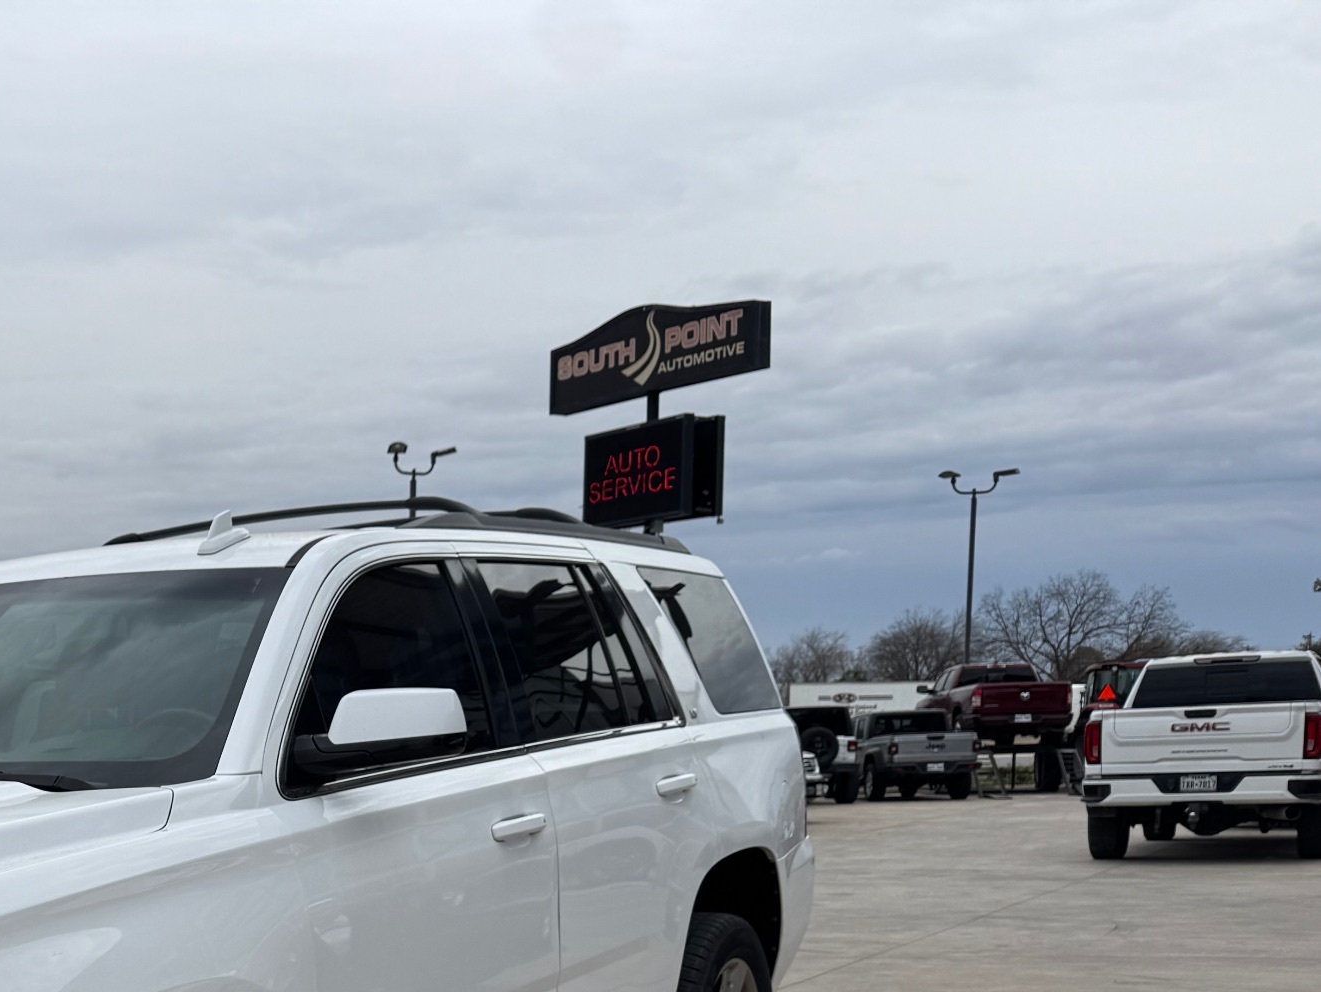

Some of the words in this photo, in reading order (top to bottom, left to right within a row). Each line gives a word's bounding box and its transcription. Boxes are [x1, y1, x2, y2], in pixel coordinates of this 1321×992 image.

[557, 337, 636, 382] SOUTH
[664, 308, 744, 354] POINT
[657, 341, 745, 375] AUTOMOTIVE
[604, 445, 661, 477] AUTO
[589, 467, 676, 504] SERVICE
[1170, 721, 1231, 733] GMC
